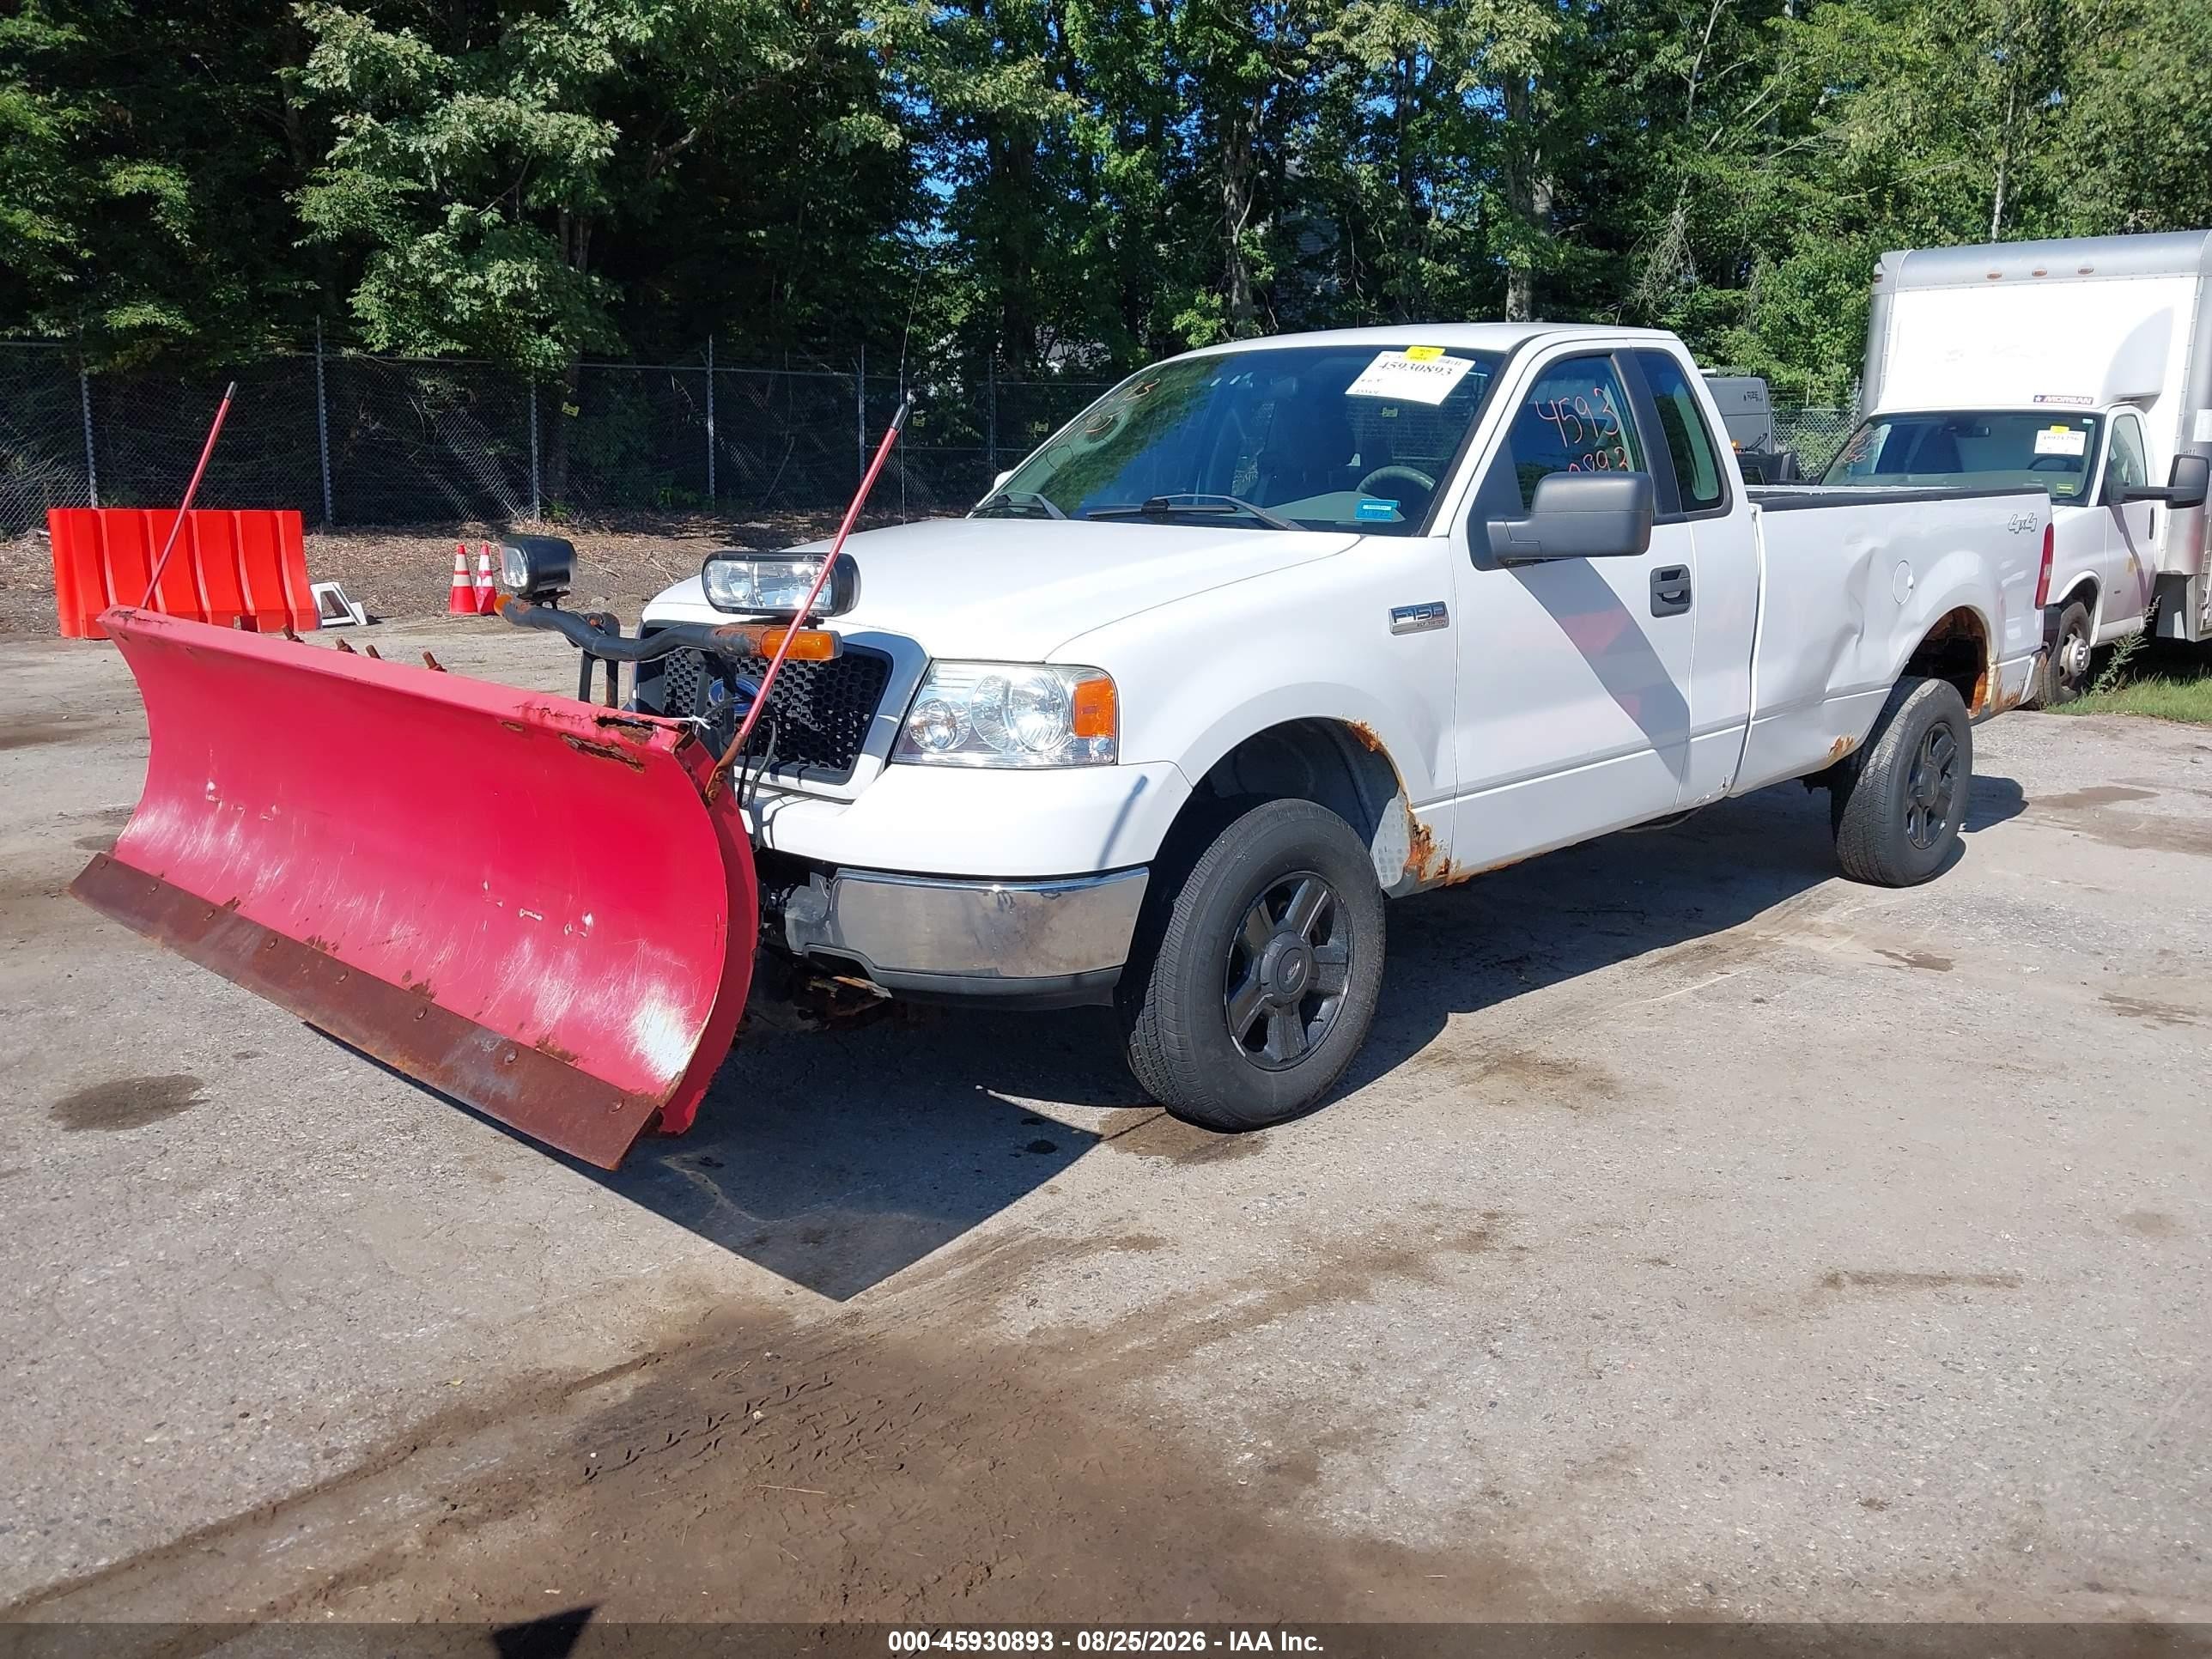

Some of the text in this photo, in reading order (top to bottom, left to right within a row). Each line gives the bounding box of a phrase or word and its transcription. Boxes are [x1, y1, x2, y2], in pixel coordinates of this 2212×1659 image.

[1378, 361, 1453, 376] 45930893
[2045, 396, 2093, 405] MORGAN
[1534, 387, 1620, 447] 4593
[2008, 513, 2038, 534] 4x4
